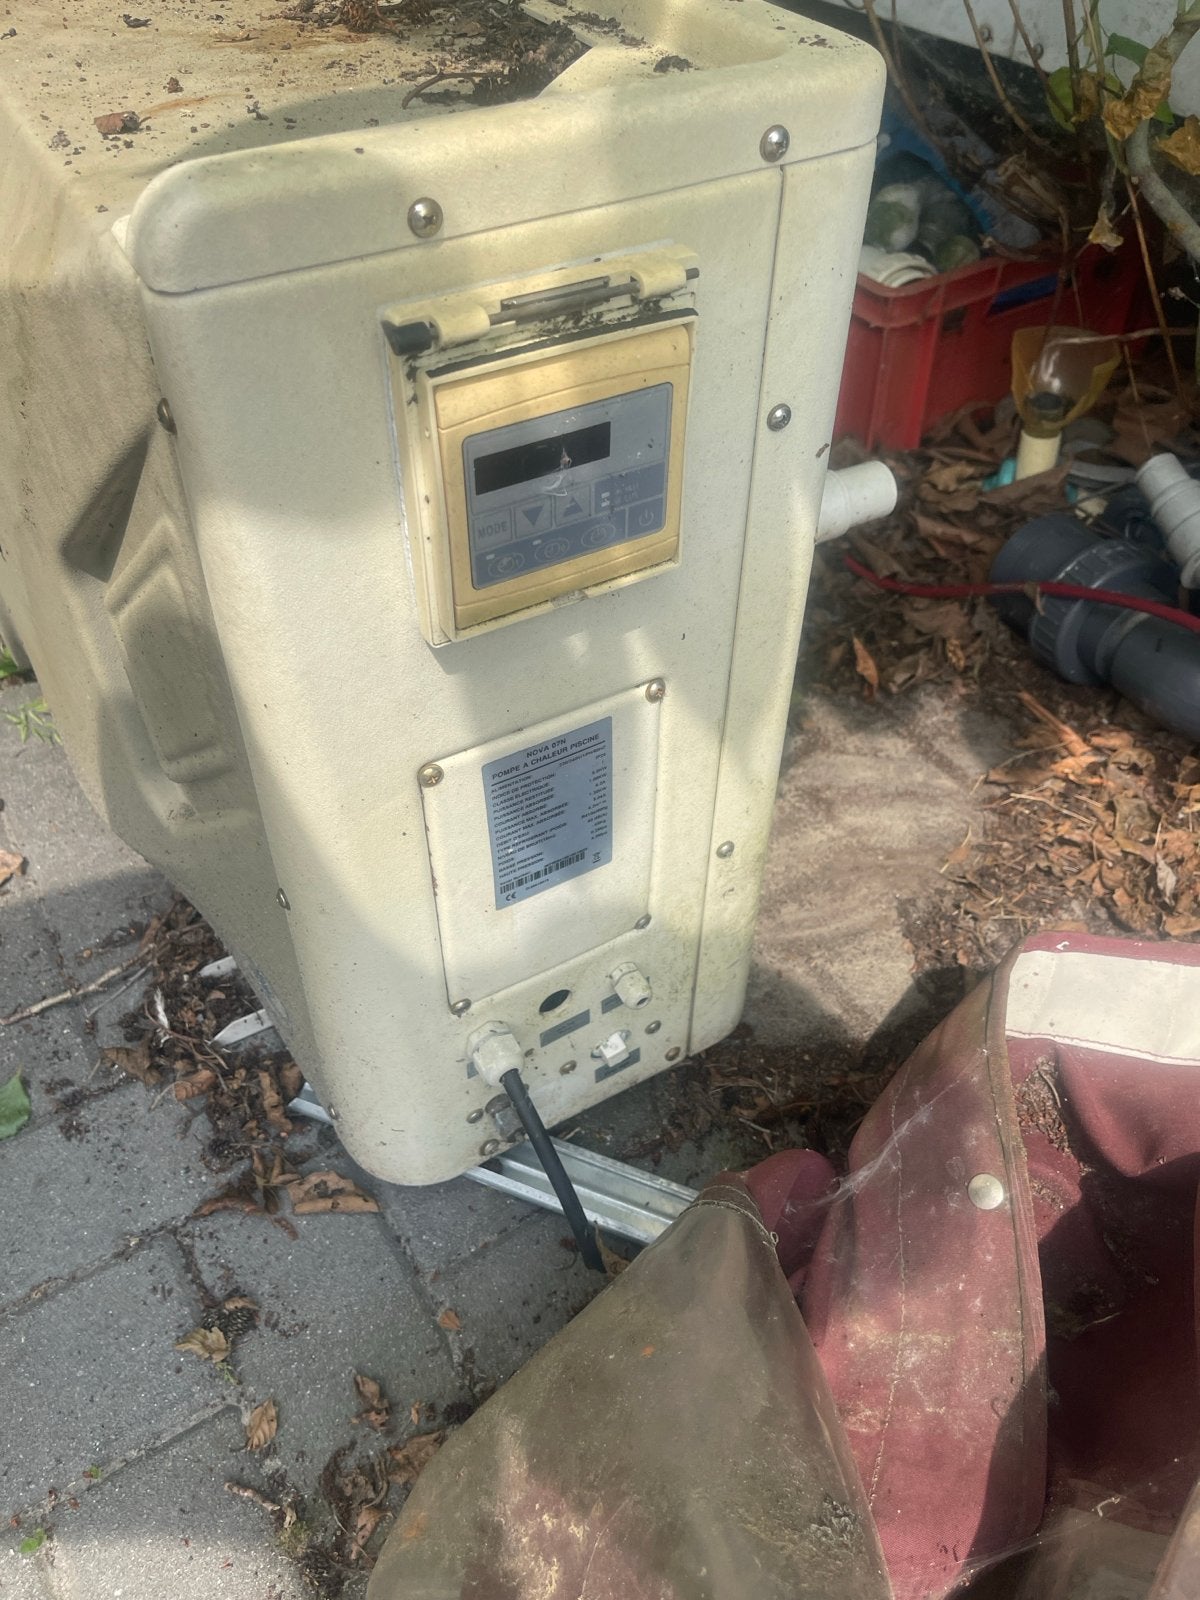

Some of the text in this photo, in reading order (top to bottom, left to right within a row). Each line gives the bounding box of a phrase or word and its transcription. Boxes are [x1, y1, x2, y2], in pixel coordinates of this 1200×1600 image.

[478, 521, 508, 539] MODE
[527, 739, 566, 758] NOVA 07N
[492, 765, 520, 780] POMPE
[531, 746, 567, 765] CHALEUR
[571, 734, 599, 750] PISCINE
[494, 800, 523, 814] PUISSANCE
[494, 806, 523, 821] PUISSANCE
[495, 815, 520, 828] COURANT
[495, 820, 525, 834] PUISSANCE
[496, 828, 521, 841] COURANT
